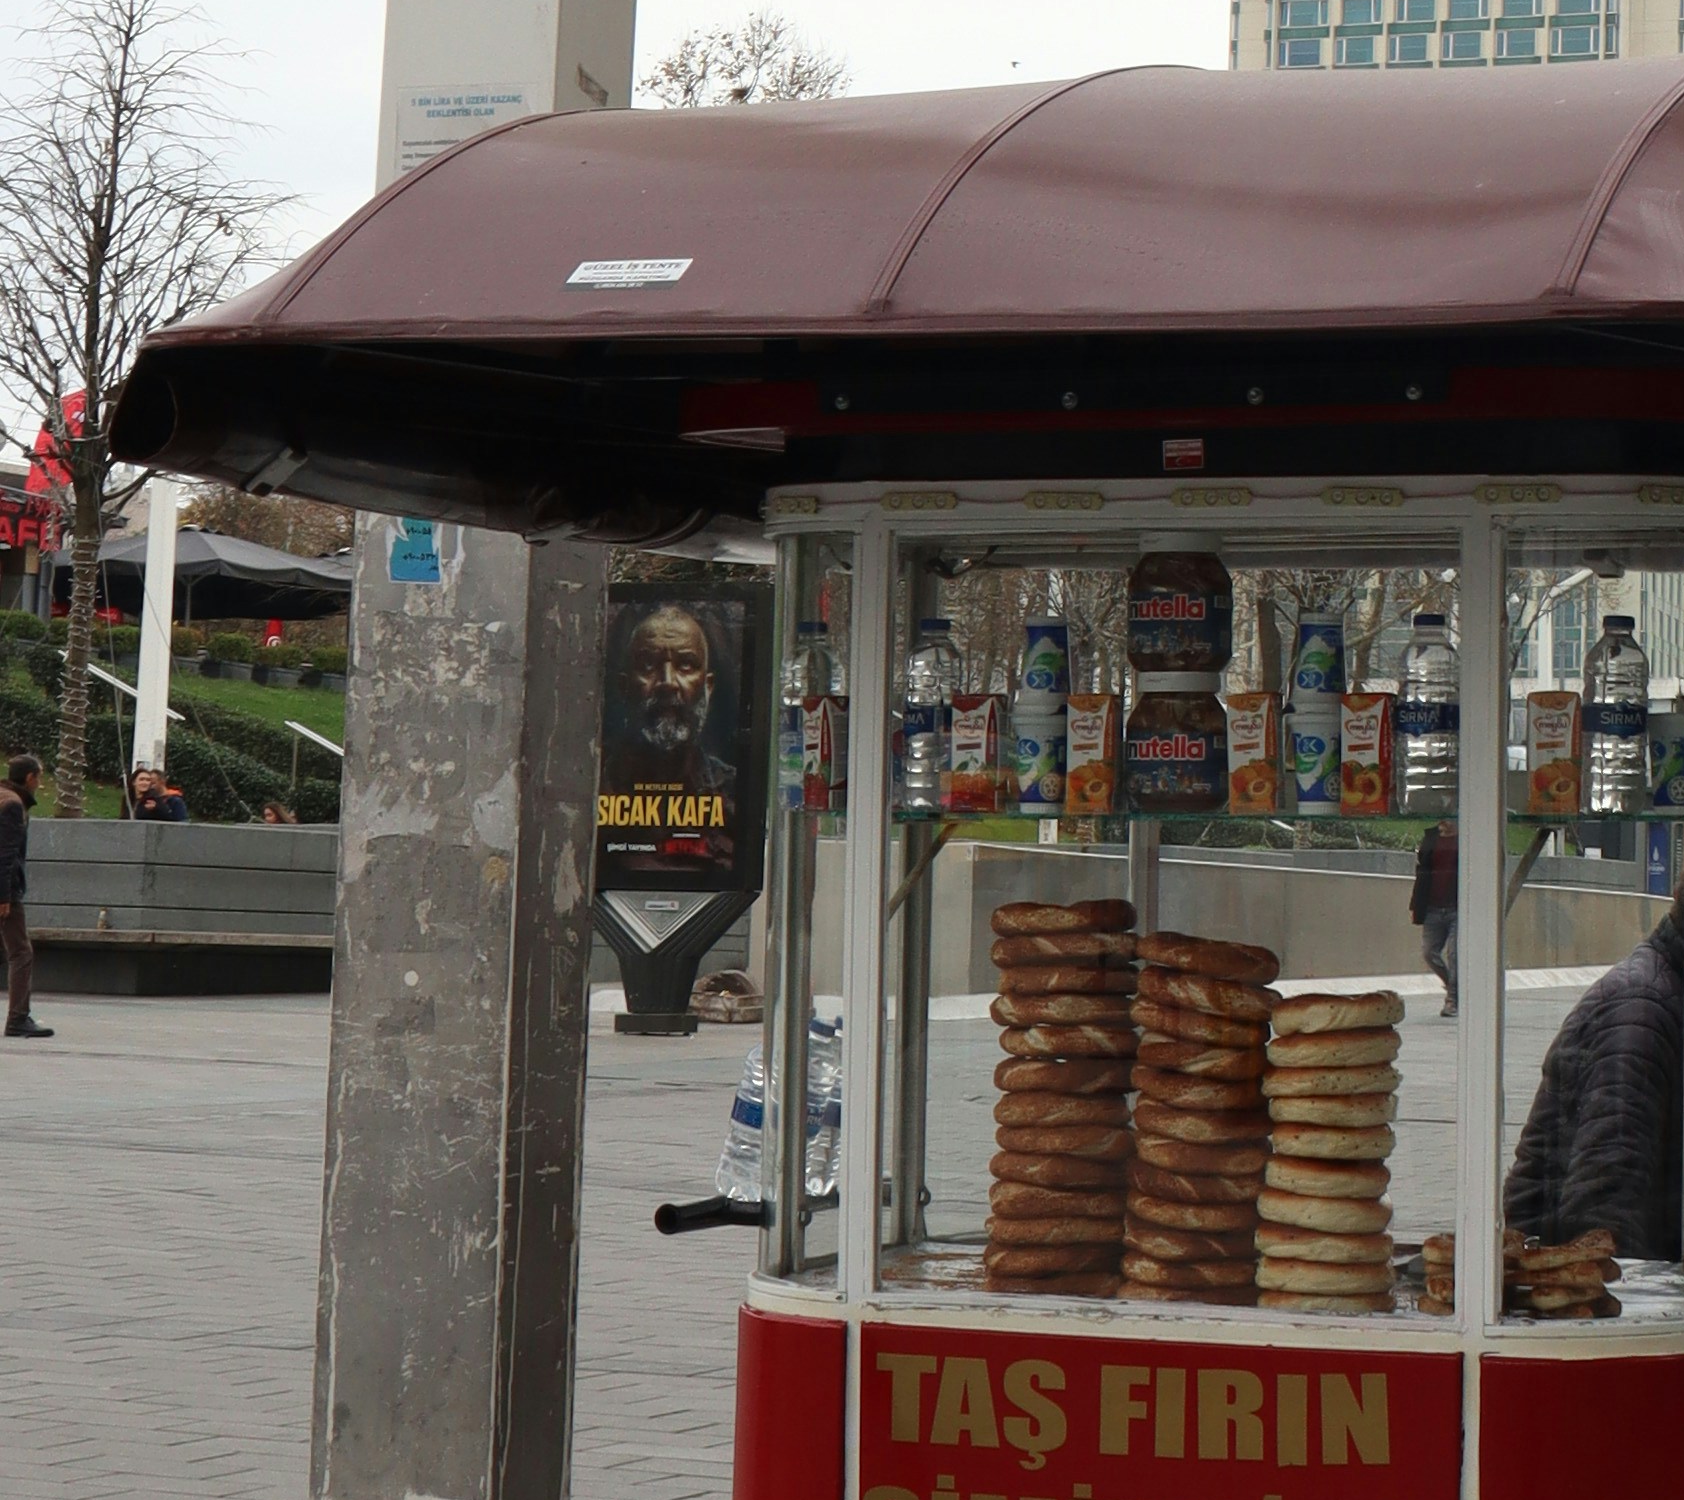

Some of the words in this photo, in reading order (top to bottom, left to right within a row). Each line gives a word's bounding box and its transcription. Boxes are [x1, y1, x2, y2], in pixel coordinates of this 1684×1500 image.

[642, 261, 684, 270] TENTE
[1129, 594, 1206, 621] nutella
[1128, 734, 1206, 762] nutella
[597, 795, 662, 826] SICAK
[666, 795, 725, 827] KAFA
[877, 1352, 1067, 1471] TAŞ
[1099, 1364, 1391, 1467] FIRIN
